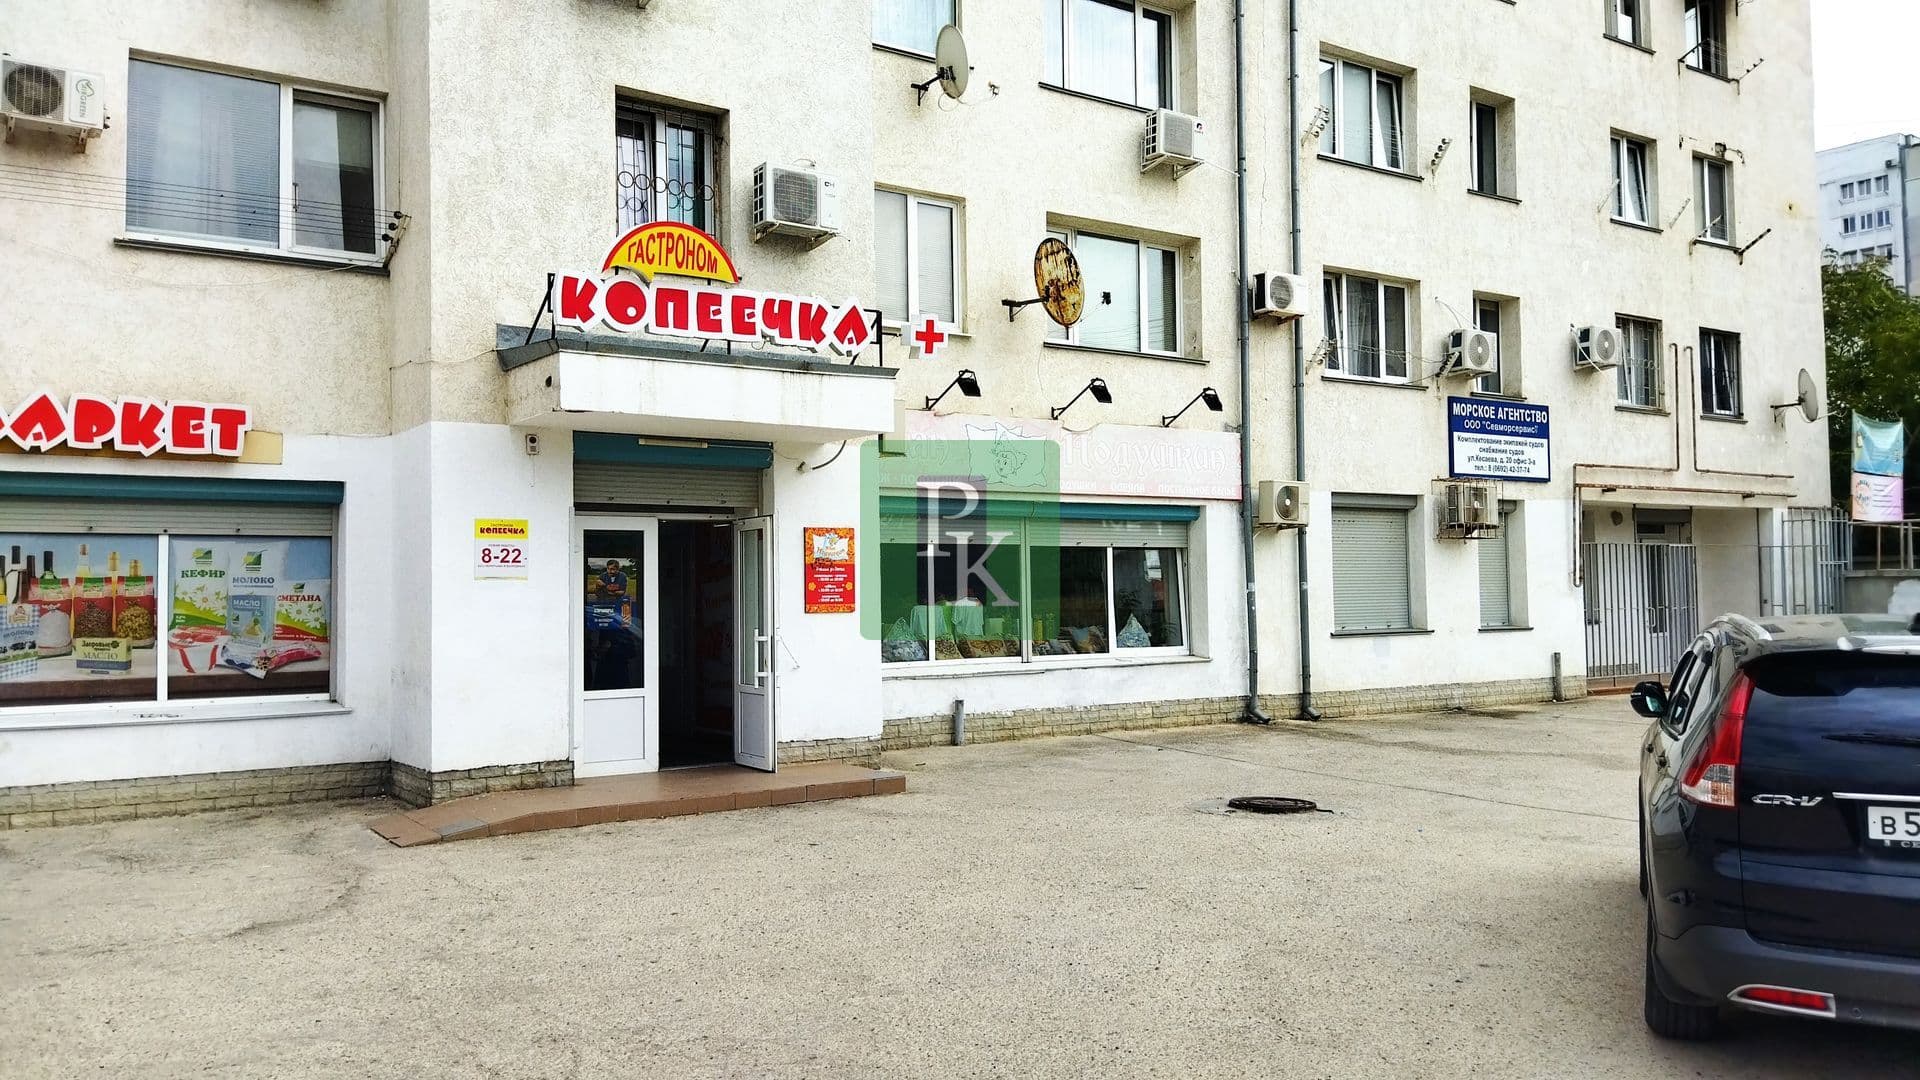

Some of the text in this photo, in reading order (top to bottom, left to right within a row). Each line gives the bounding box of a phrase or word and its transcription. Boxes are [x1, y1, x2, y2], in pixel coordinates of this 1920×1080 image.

[626, 231, 719, 275] ГАСТРОНОМ
[559, 274, 871, 347] КОПЕЕЧКА
[1453, 402, 1548, 423] МОРСКОЕ АГЕНТСТВО
[0, 393, 248, 452] АРКЕТ
[1464, 419, 1481, 429] ООО
[480, 526, 525, 534] КОПЕЕЧКА
[481, 547, 522, 563] 8-22
[181, 569, 226, 579] КЕФИР
[232, 576, 275, 584] МОЛОКО
[278, 594, 321, 603] СМЕТАНА
[1752, 794, 1823, 806] CR-V
